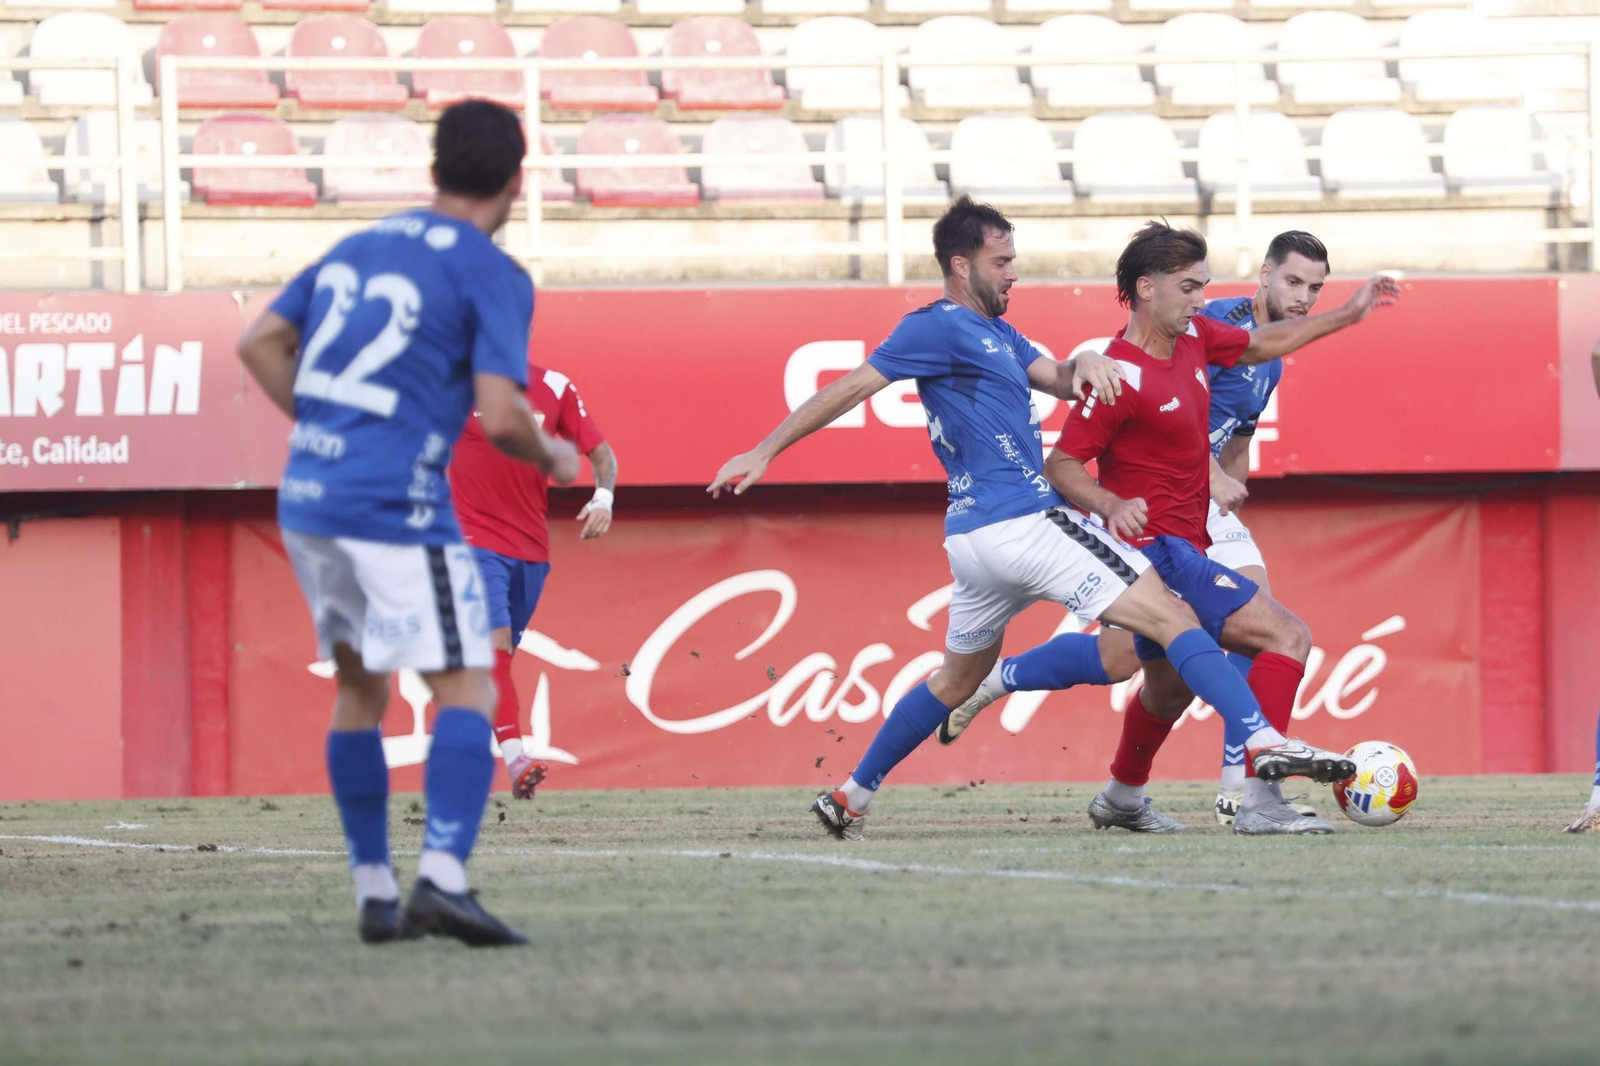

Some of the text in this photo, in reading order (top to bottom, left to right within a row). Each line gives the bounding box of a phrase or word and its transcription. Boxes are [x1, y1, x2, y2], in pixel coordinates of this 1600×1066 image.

[29, 312, 112, 334] PESCADO
[293, 262, 422, 418] 22
[32, 435, 130, 465] Calidad
